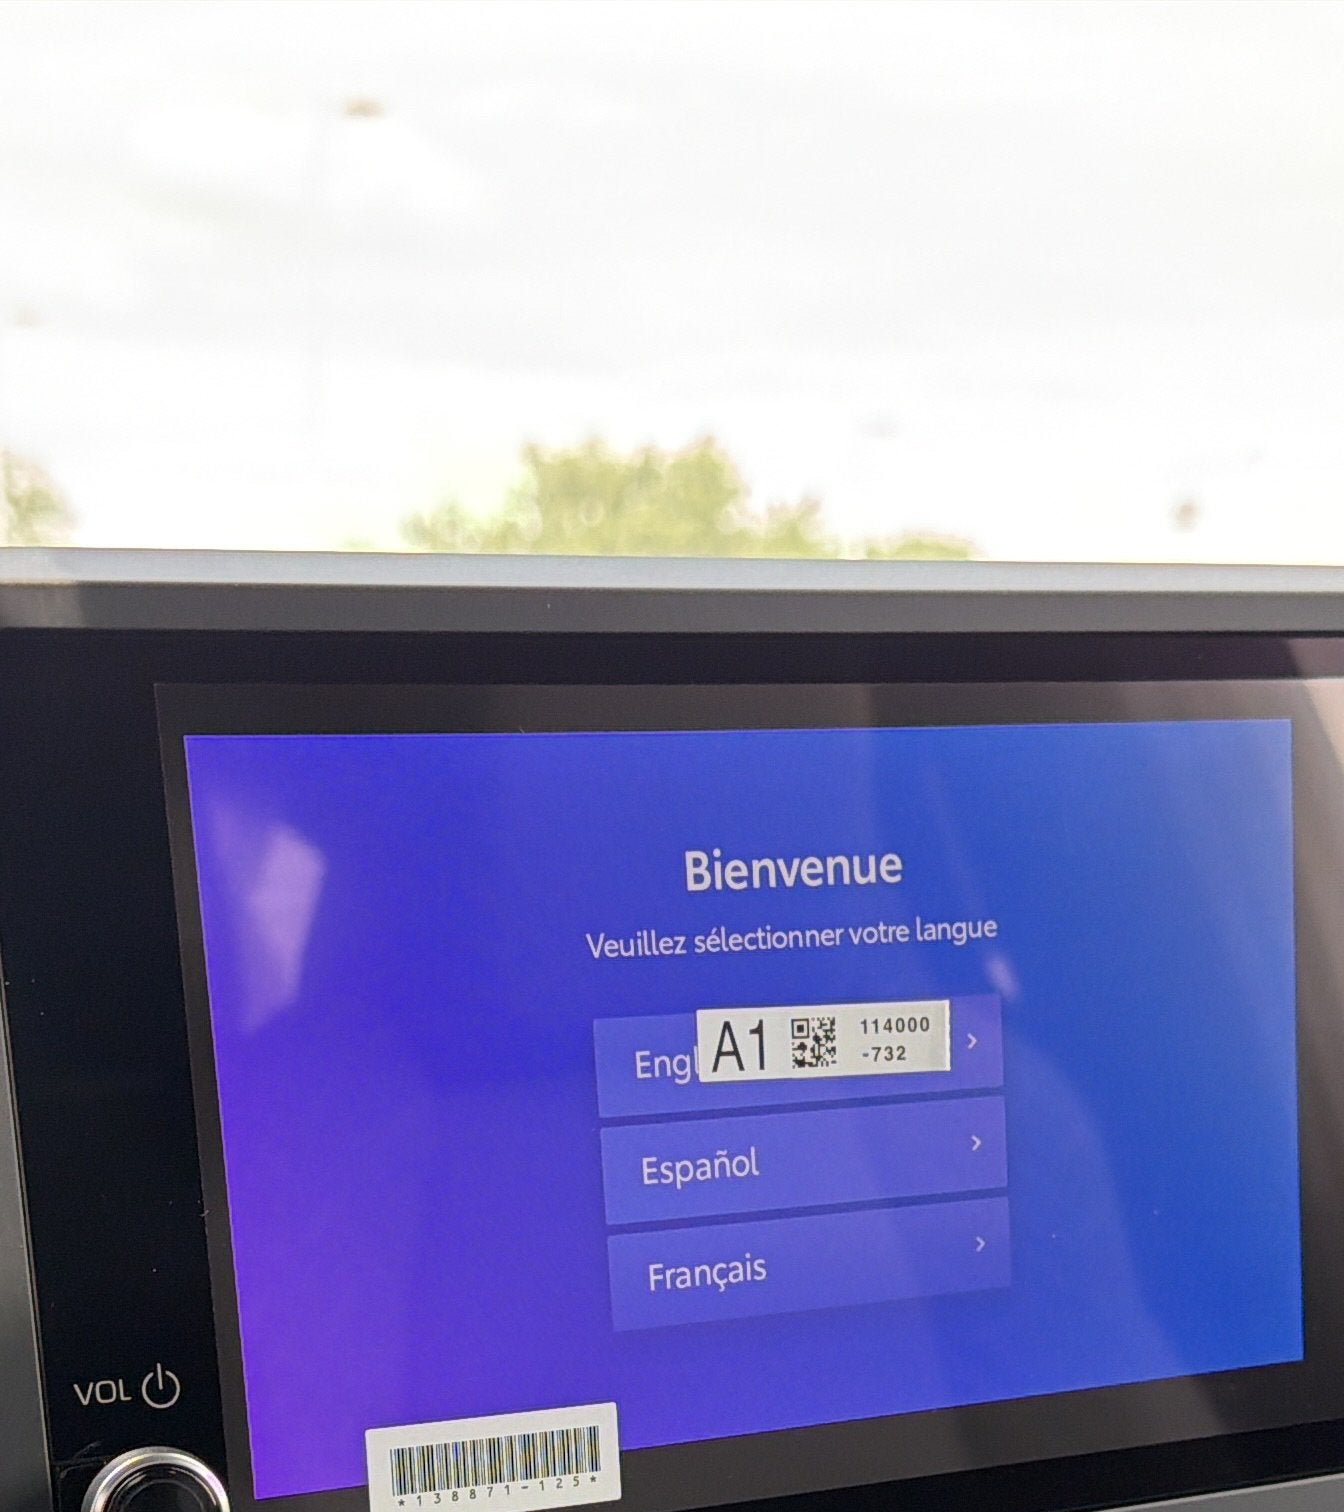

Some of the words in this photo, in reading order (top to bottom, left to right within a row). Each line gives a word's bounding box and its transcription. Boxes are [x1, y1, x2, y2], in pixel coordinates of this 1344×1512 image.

[684, 847, 903, 893] Bienvenue
[586, 931, 687, 960] Veuillez
[693, 922, 844, 955] sélectionner
[849, 920, 910, 946] votre
[916, 916, 999, 947] langue
[635, 1045, 699, 1085] Engl
[711, 1018, 768, 1073] A1
[860, 1016, 931, 1036] 114000
[862, 1045, 908, 1063] -732
[642, 1147, 760, 1189] Español
[648, 1252, 768, 1294] Français
[73, 1378, 132, 1406] VOL
